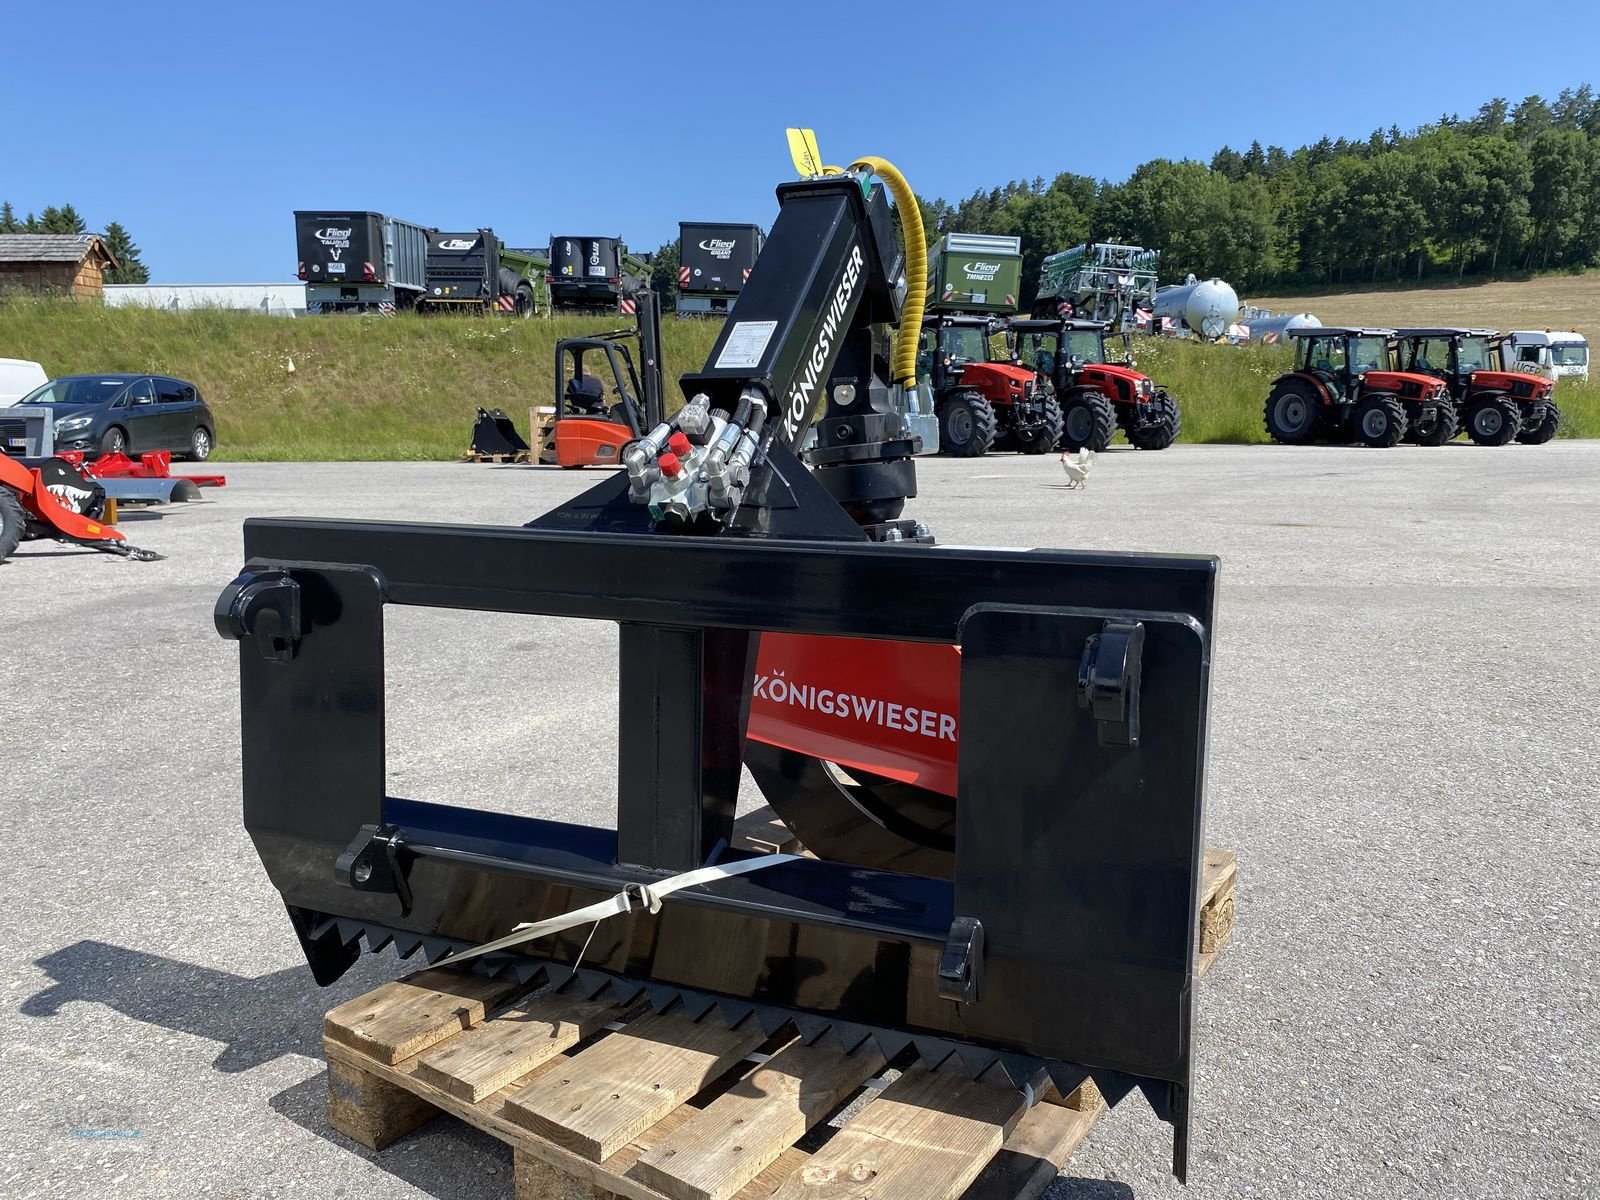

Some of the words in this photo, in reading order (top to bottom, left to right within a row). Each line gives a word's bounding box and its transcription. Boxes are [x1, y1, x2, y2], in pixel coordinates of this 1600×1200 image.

[326, 228, 352, 238] Fliegl
[449, 239, 477, 249] Fliegl
[710, 239, 736, 250] Fliegl
[974, 262, 1001, 273] Fliegl
[783, 245, 864, 443] KÖNIGSWIESER
[753, 668, 956, 742] KÖNIGSWIESER
